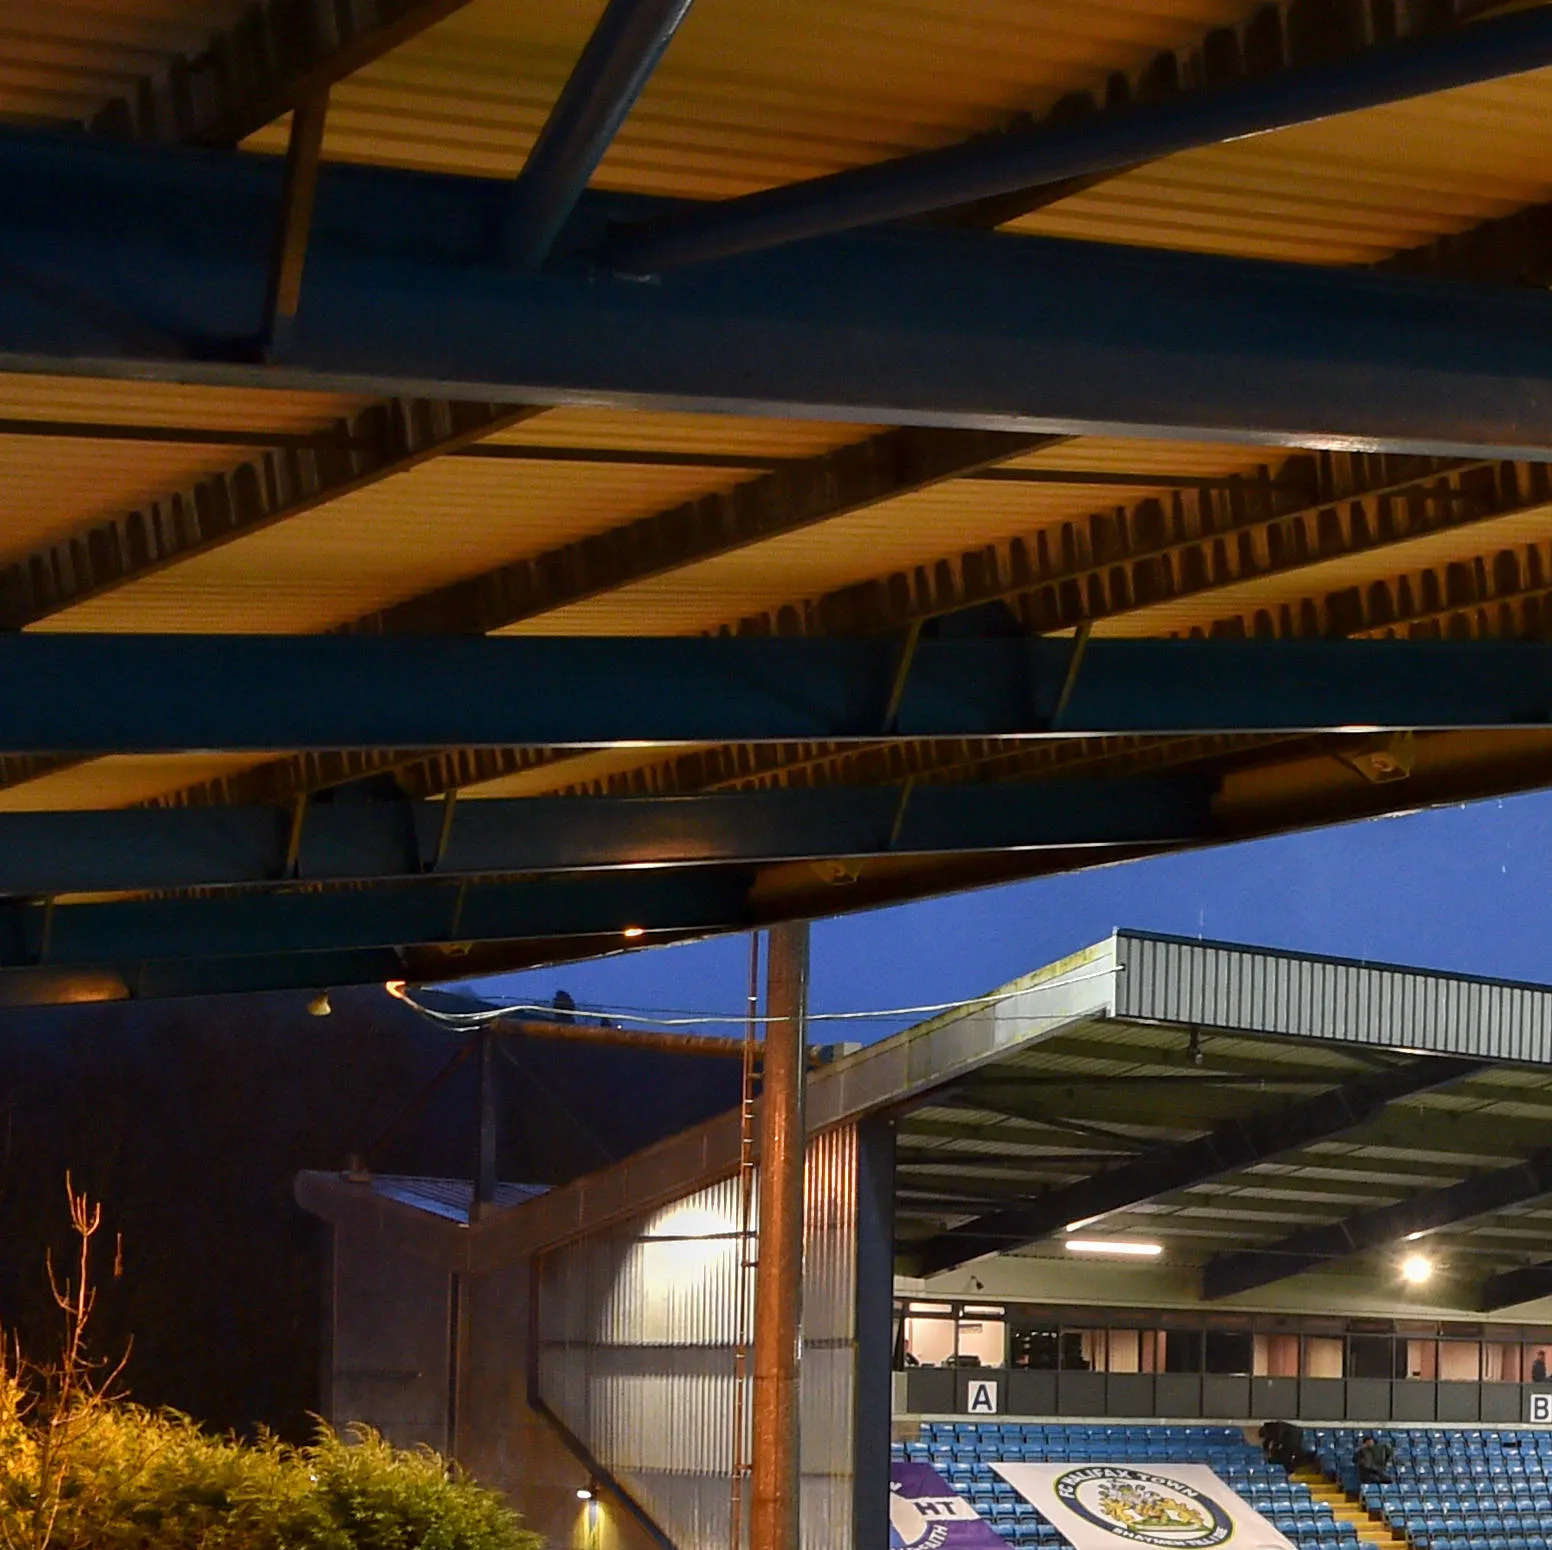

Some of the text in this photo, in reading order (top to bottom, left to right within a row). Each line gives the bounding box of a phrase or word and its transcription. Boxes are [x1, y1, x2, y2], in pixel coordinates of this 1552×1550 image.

[971, 1384, 993, 1411] A
[1534, 1397, 1549, 1420] B
[1065, 1467, 1133, 1489] HALIFAX
[1139, 1473, 1199, 1498] TOWN
